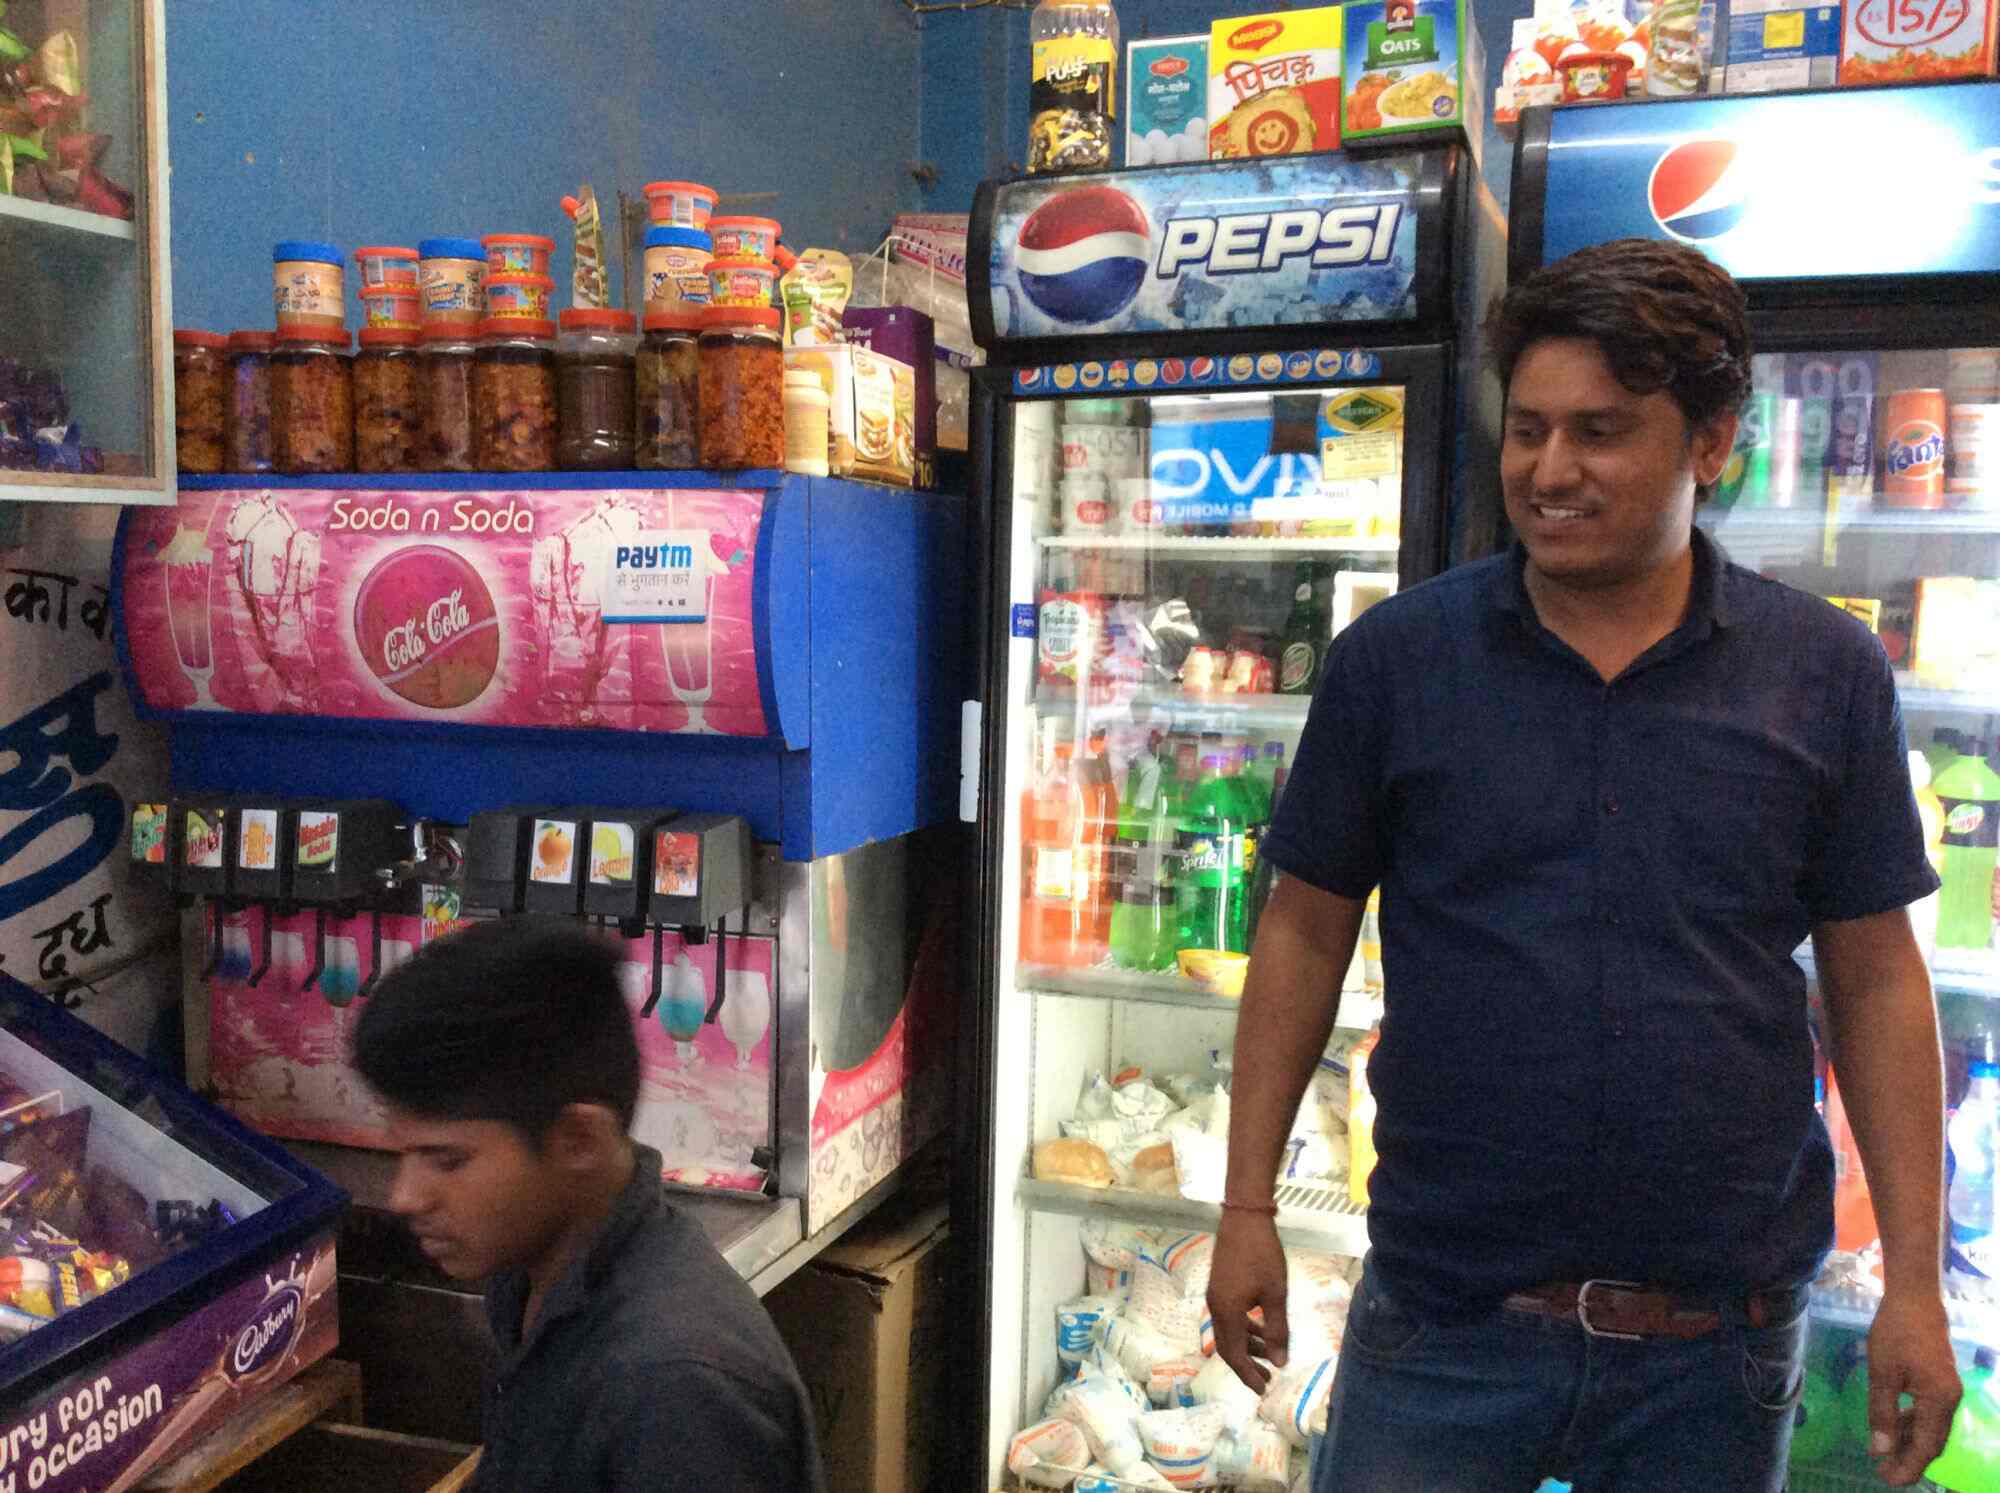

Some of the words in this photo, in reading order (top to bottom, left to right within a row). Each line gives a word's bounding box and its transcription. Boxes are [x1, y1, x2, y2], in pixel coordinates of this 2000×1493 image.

[1380, 38, 1421, 55] OATS
[1156, 202, 1402, 279] PEPSI
[329, 499, 411, 531] Soda
[420, 508, 440, 531] n
[450, 500, 534, 533] Soda
[616, 542, 692, 569] paytm
[234, 1299, 294, 1372] Cadbury
[58, 1376, 112, 1433] for
[28, 1383, 163, 1490] occasion
